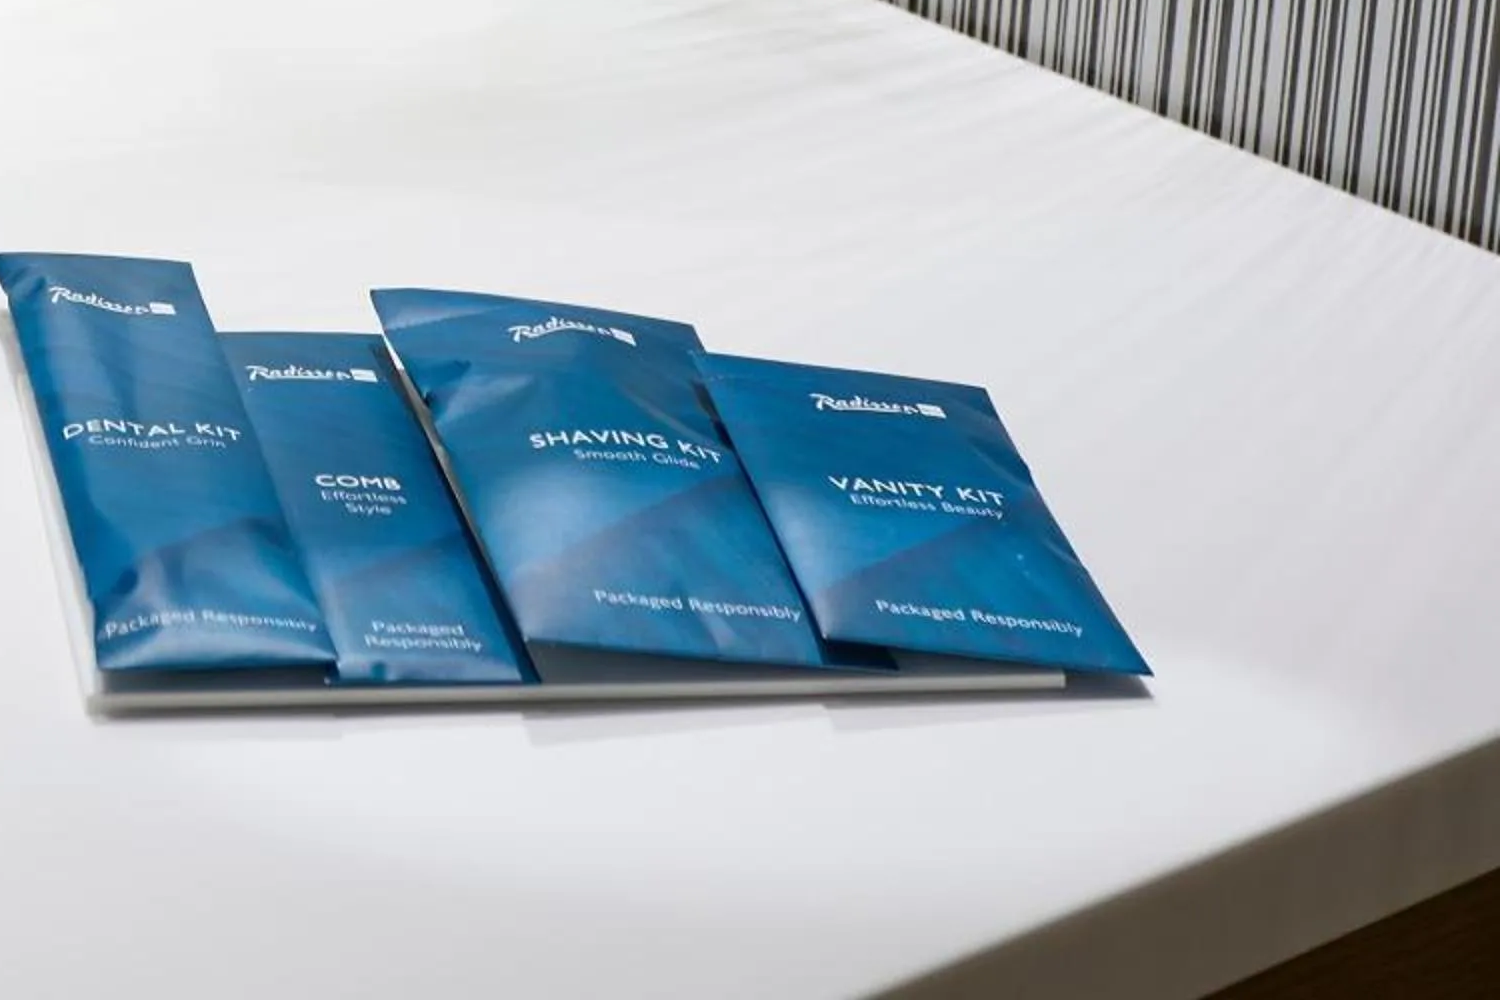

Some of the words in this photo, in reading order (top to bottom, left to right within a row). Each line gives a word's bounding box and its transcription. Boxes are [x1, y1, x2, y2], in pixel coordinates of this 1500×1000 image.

[49, 285, 150, 315] Radisson
[507, 316, 613, 343] Radisson
[246, 364, 351, 382] Radisson
[809, 392, 920, 415] Radisson
[62, 418, 186, 440] DENTAL
[195, 422, 241, 441] KIT
[88, 434, 180, 448] Confident
[186, 435, 227, 449] Grin
[529, 430, 669, 450] SHAVING
[677, 439, 722, 464] KIT
[573, 449, 648, 463] Smooth
[652, 453, 701, 470] Glide
[315, 474, 401, 491] COMB
[828, 476, 944, 499] VANITY
[956, 487, 1004, 506] KIT
[321, 490, 407, 505] Effortless
[346, 502, 392, 516] Style
[851, 495, 937, 512] Effortless
[941, 501, 1004, 520] Beauty
[593, 589, 683, 611] Packaged
[688, 597, 800, 623] Responsibly
[104, 610, 195, 640] Packaged
[371, 621, 464, 637] Packaged
[876, 599, 965, 622] Packaged
[970, 608, 1083, 639] Responsibly
